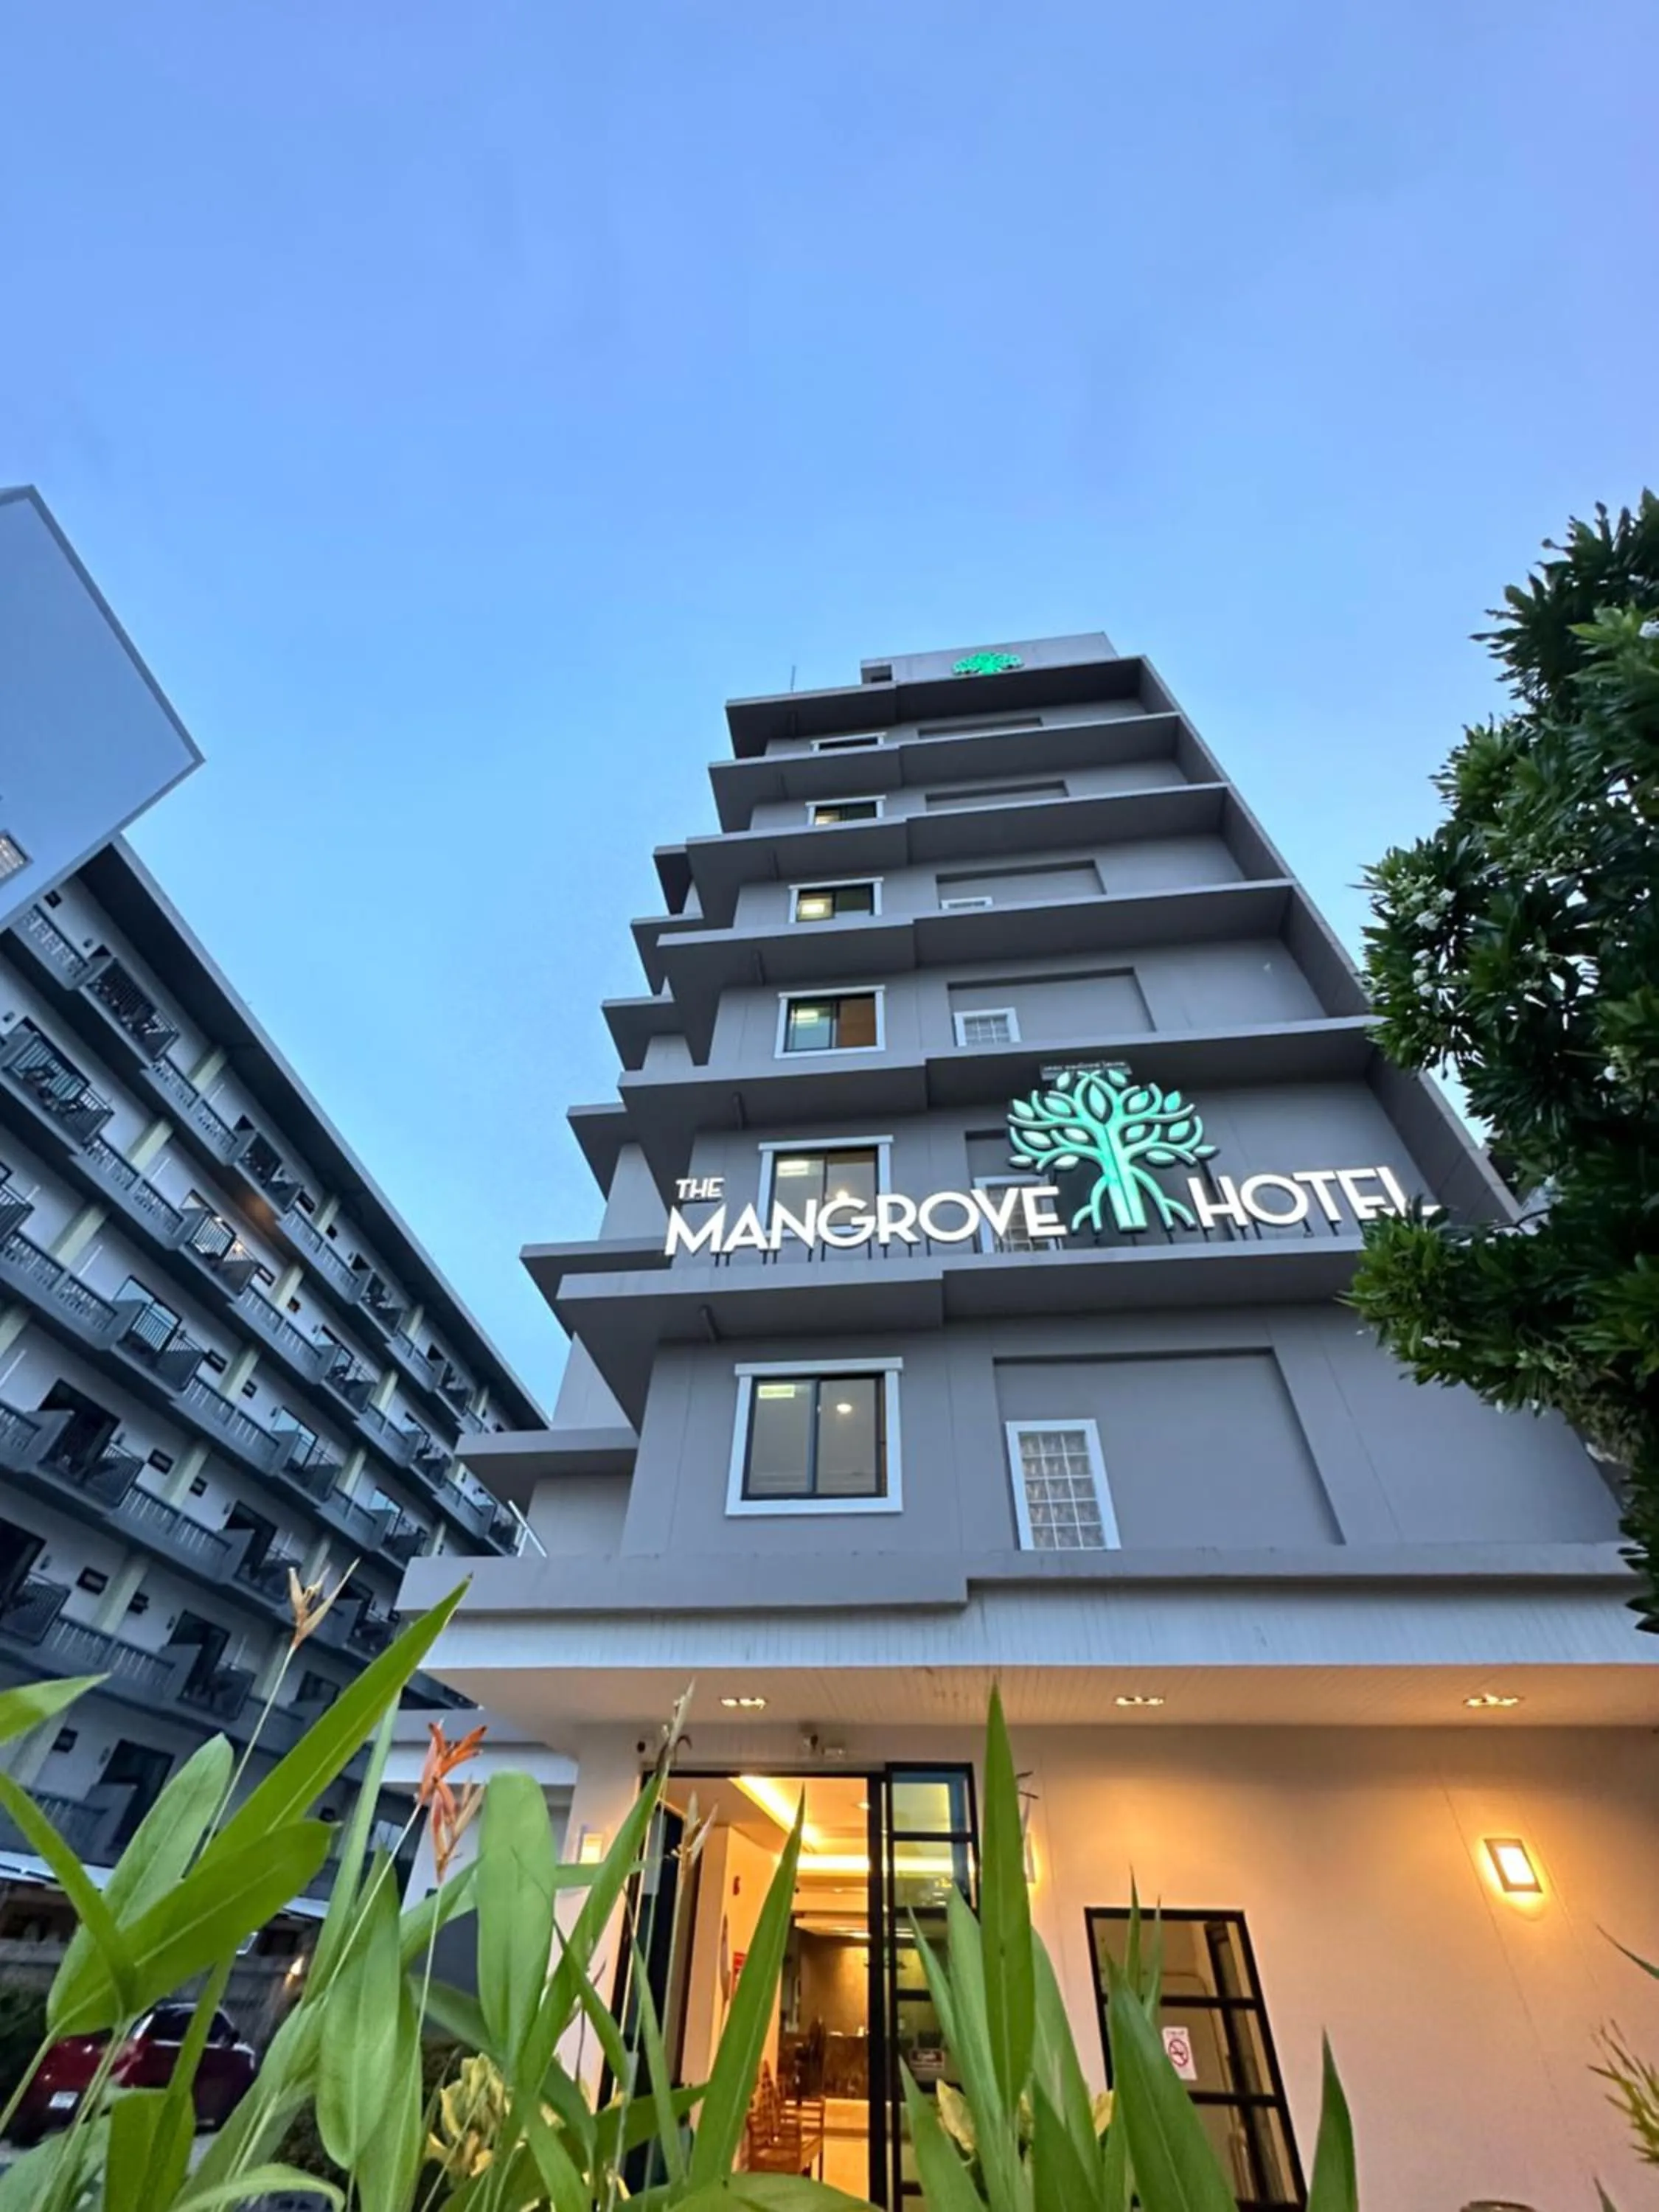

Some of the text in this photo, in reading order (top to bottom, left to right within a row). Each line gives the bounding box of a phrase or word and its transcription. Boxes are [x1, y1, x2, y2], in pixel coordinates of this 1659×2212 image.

[664, 1166, 1441, 1256] MANGROVE HOTEL
[676, 1178, 725, 1200] THE
